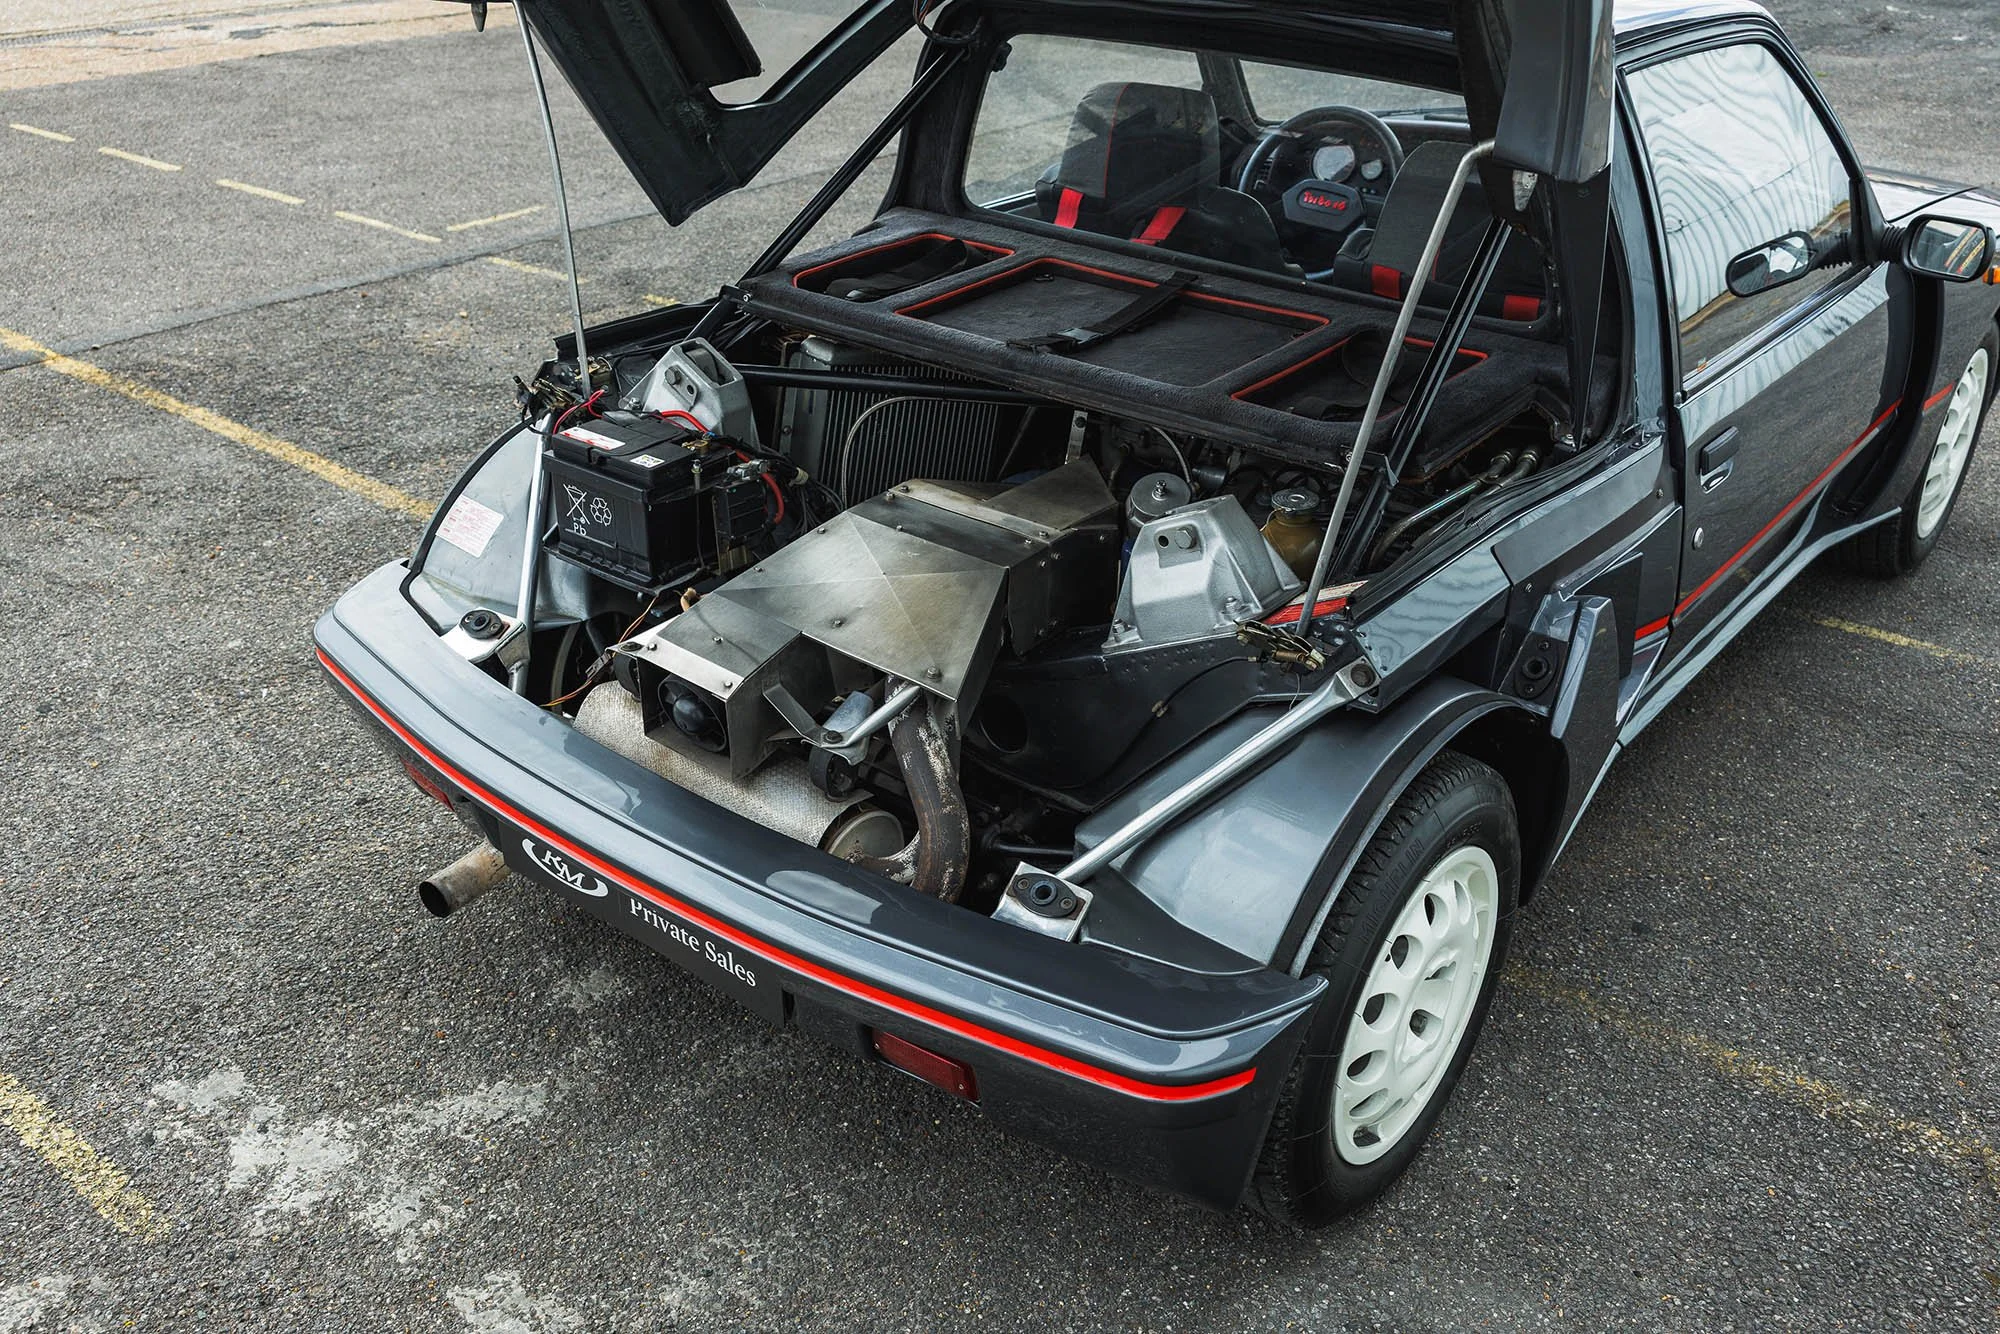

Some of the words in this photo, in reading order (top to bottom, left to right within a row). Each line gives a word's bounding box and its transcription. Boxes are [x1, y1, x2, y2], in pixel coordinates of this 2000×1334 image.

[573, 522, 587, 536] Pb
[1359, 838, 1425, 944] MICHELIN
[630, 897, 700, 952] Private
[705, 940, 757, 987] Sales
